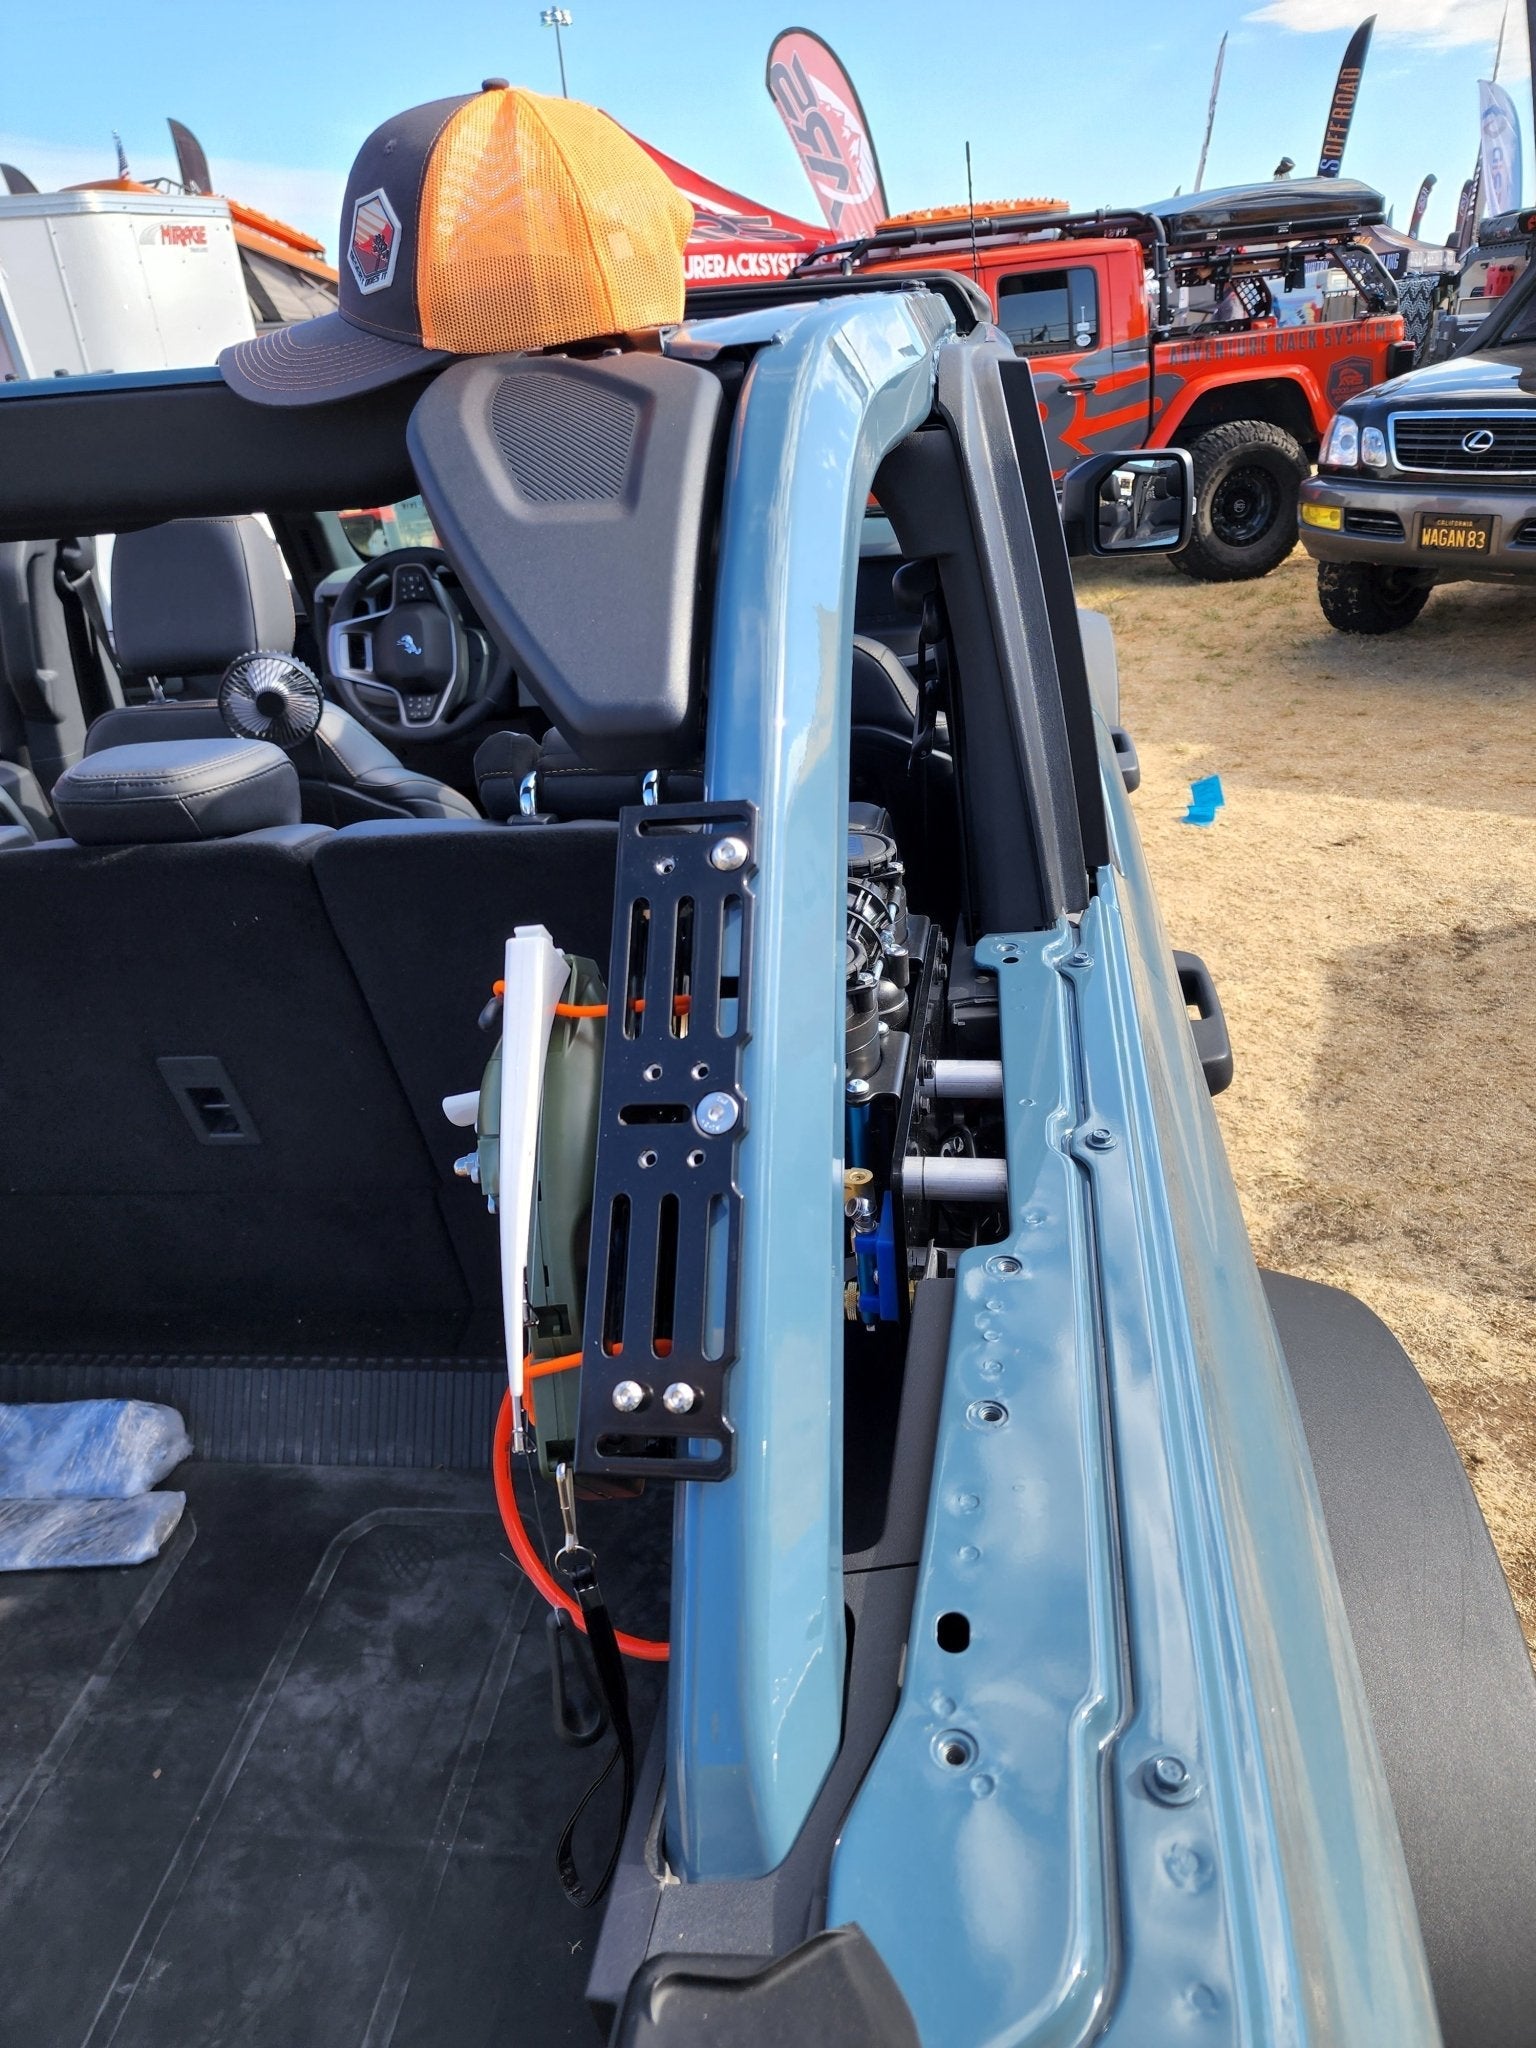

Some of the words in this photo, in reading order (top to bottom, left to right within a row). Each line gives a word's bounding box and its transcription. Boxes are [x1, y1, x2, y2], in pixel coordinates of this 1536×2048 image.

[160, 224, 207, 247] MIRAGE
[1169, 335, 1268, 365] ADVENTURE
[1275, 330, 1317, 353] RACK
[1324, 319, 1396, 347] SYSTEMS
[1437, 519, 1473, 527] CALIFORNIA
[1421, 528, 1466, 548] WAGAN
[1467, 530, 1486, 549] 83
